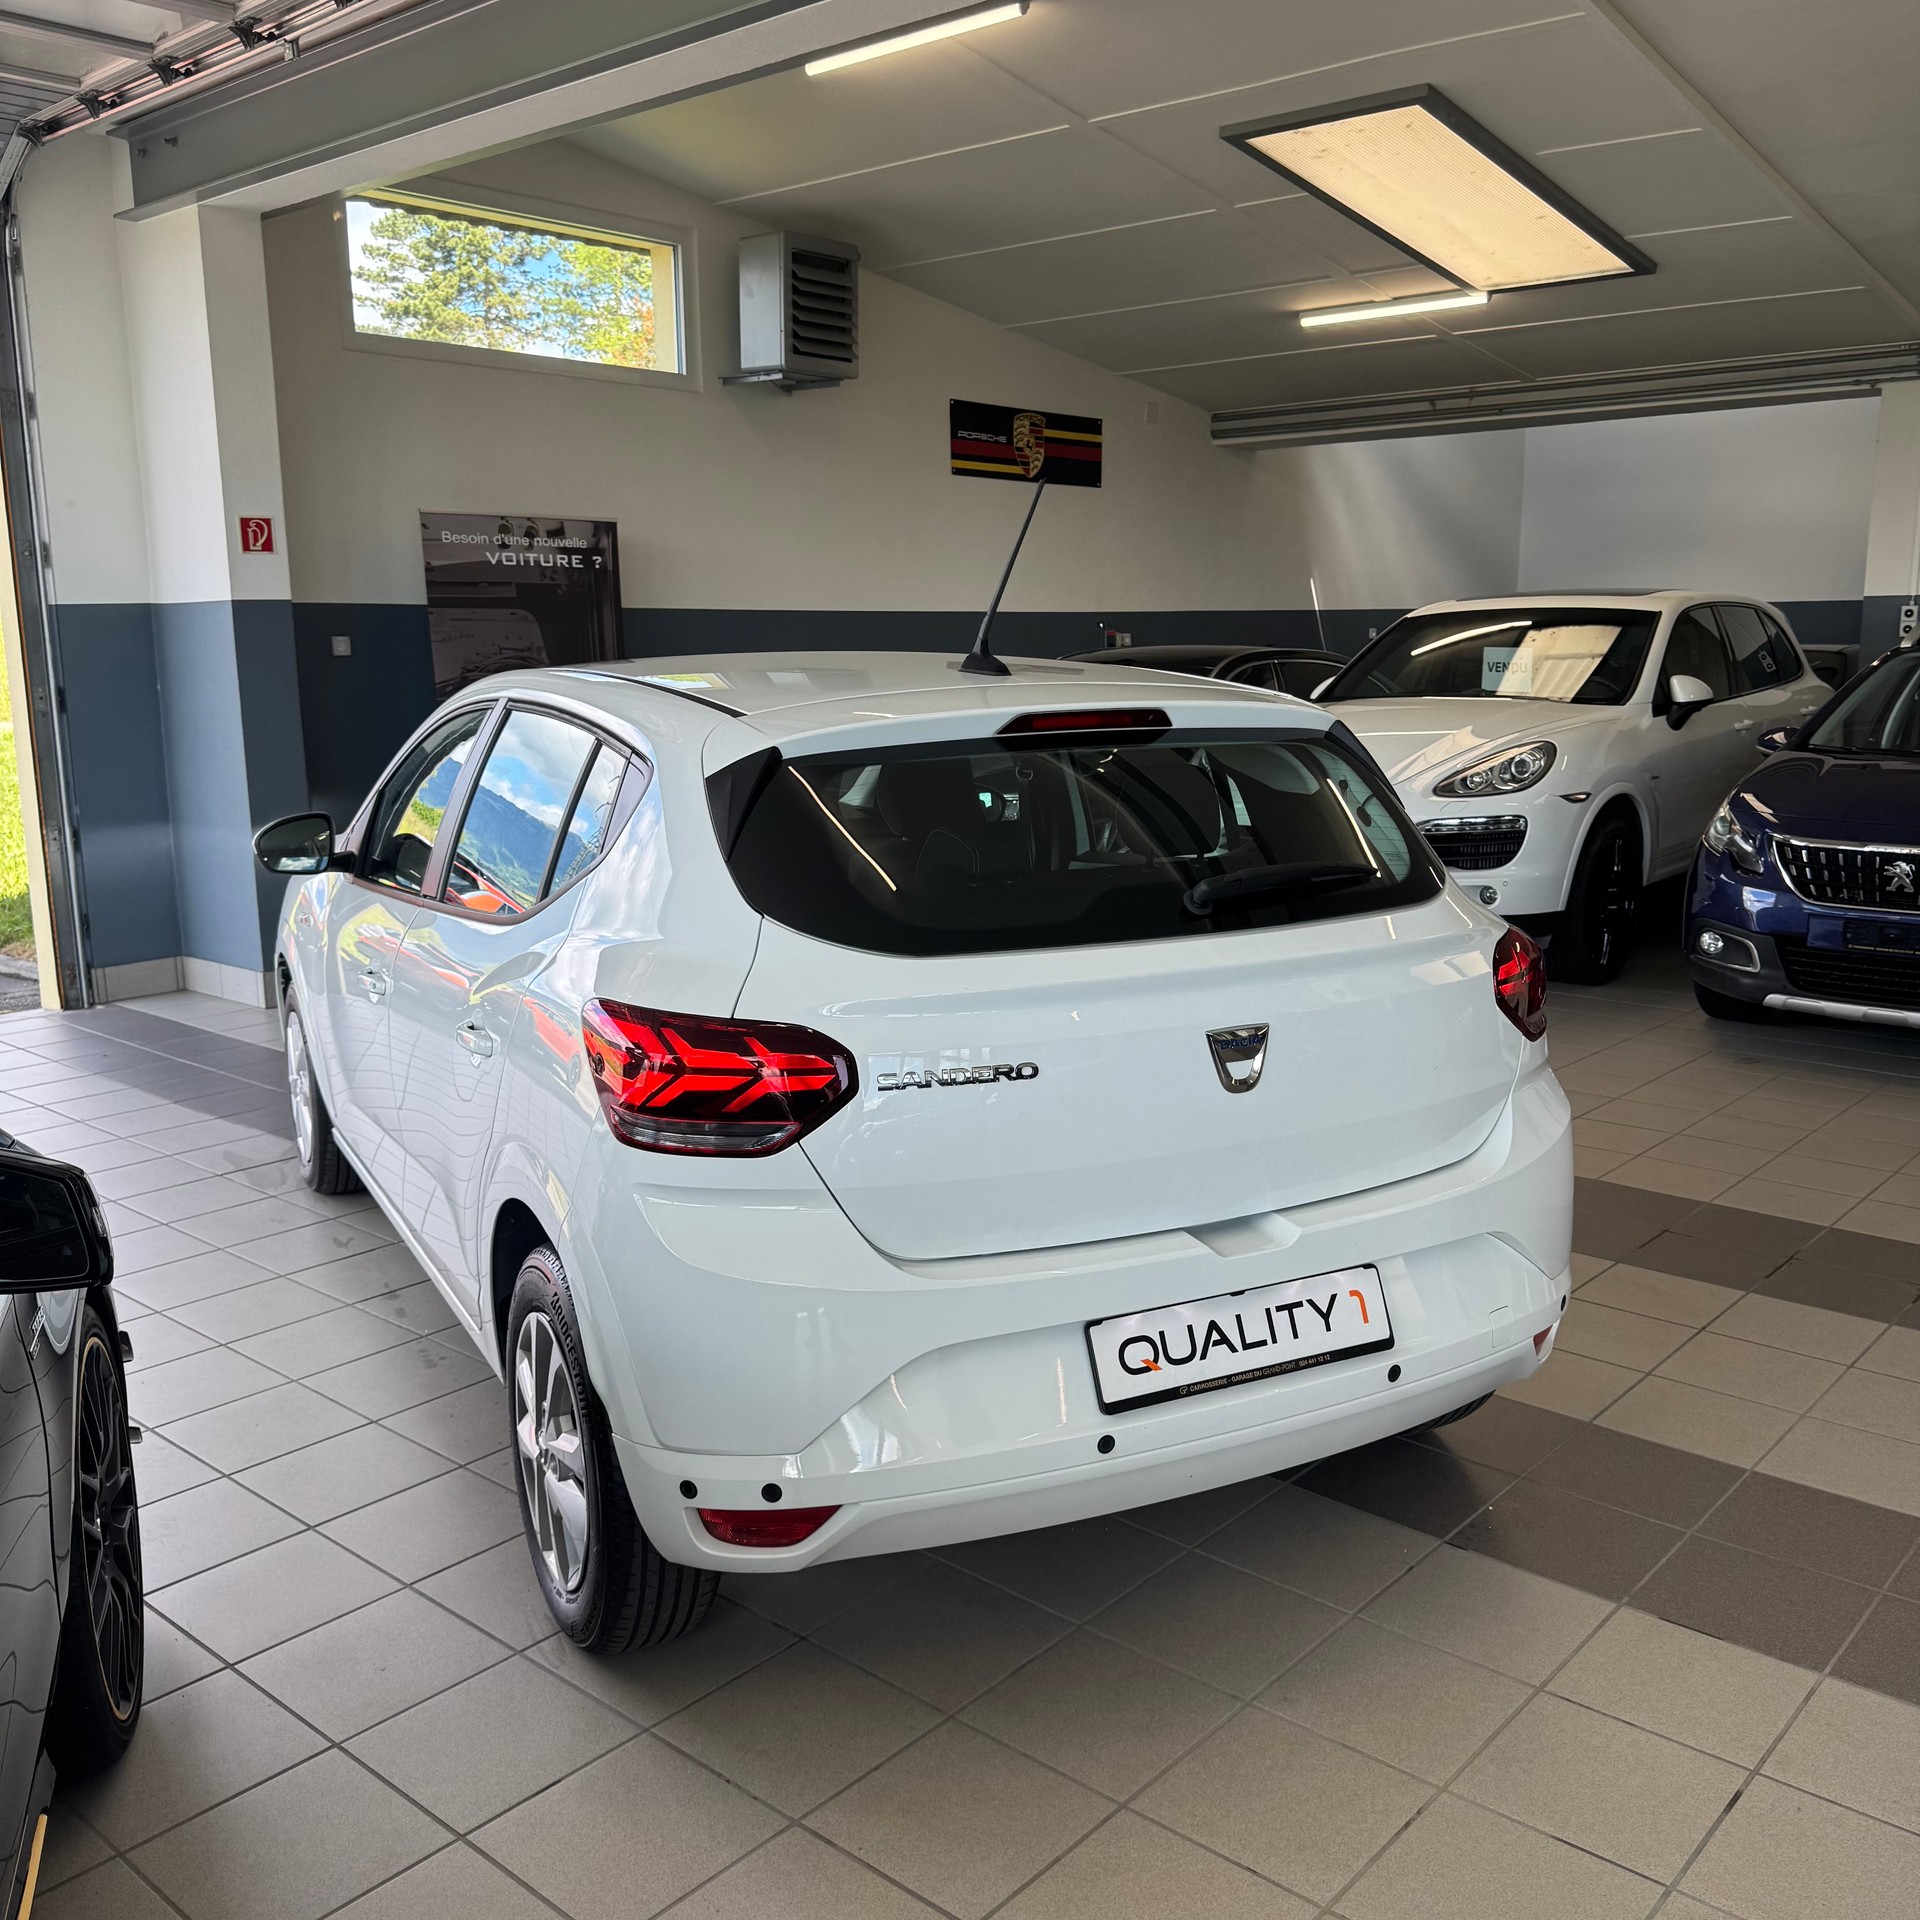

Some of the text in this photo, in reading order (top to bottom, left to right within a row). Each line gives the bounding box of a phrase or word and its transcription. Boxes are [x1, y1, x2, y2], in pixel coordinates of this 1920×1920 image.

[958, 430, 1007, 443] PORSCHE
[441, 531, 587, 548] Besoin d'une nouvelle
[486, 552, 602, 569] VOITURE ?
[1487, 661, 1528, 673] VENDU
[1219, 1035, 1264, 1050] DACIA
[876, 1061, 1039, 1091] SANDERO
[1118, 1290, 1369, 1376] QUALITY 1
[1190, 1379, 1228, 1392] CARROSSERIE
[1231, 1371, 1254, 1383] GARAGE
[1254, 1370, 1263, 1378] DU
[1262, 1362, 1297, 1375] GRAND-PONT
